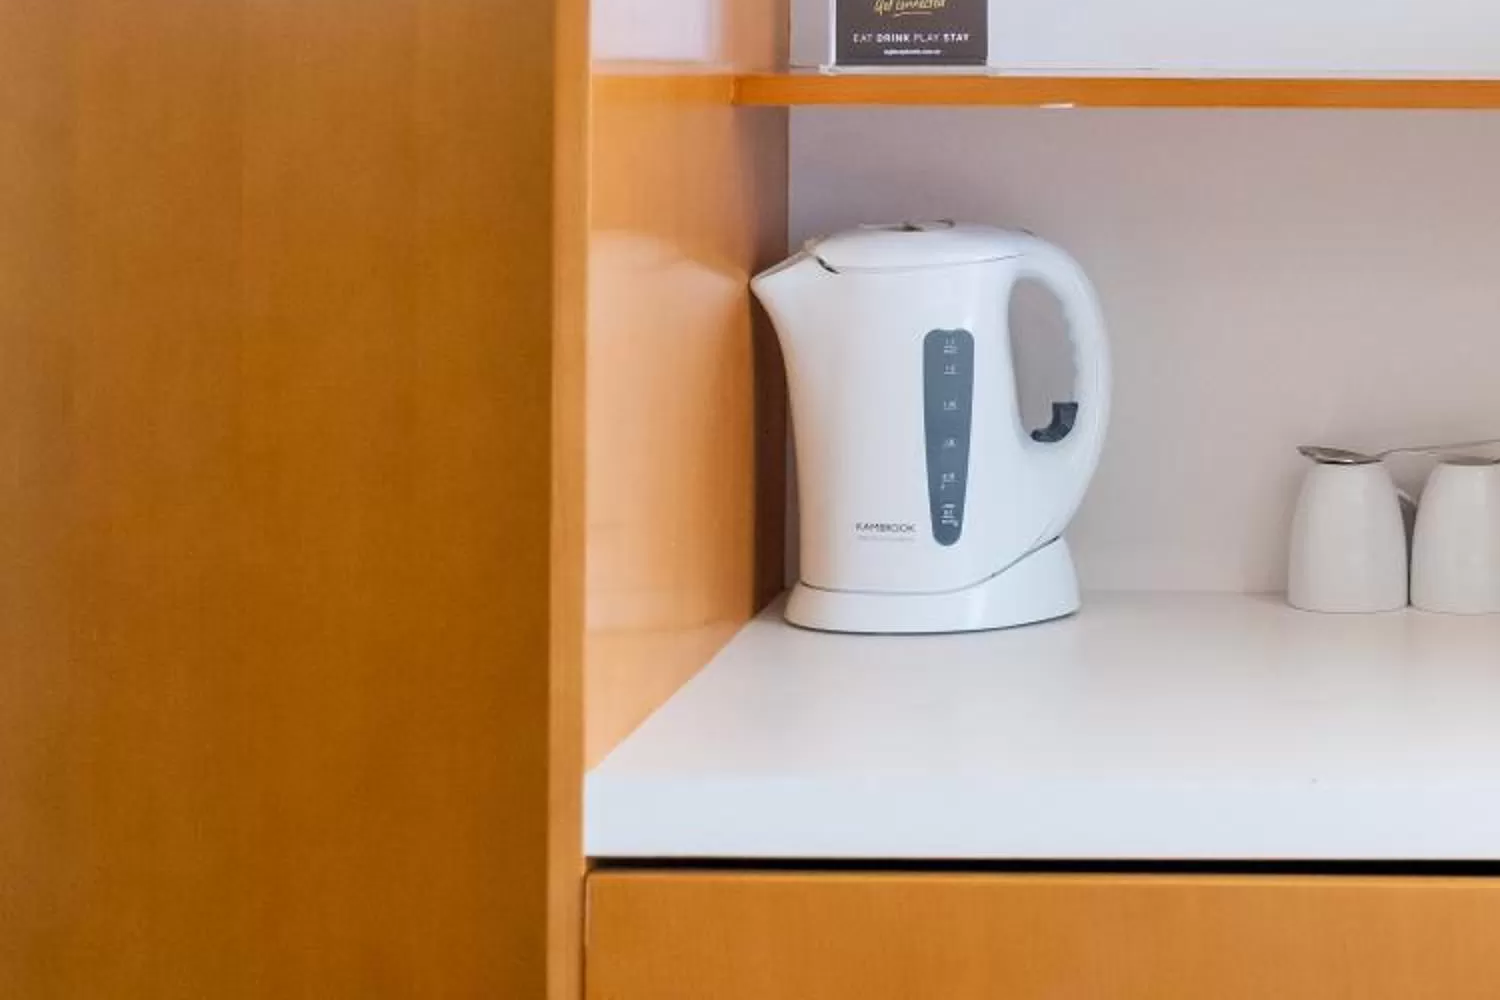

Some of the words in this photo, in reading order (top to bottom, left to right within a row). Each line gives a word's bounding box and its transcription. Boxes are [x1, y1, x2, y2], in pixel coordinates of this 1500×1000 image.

[852, 33, 873, 43] EAT
[876, 33, 911, 43] DRINK
[913, 33, 939, 43] PLAY
[943, 33, 969, 43] STAY
[855, 522, 917, 533] KAMBROOK
